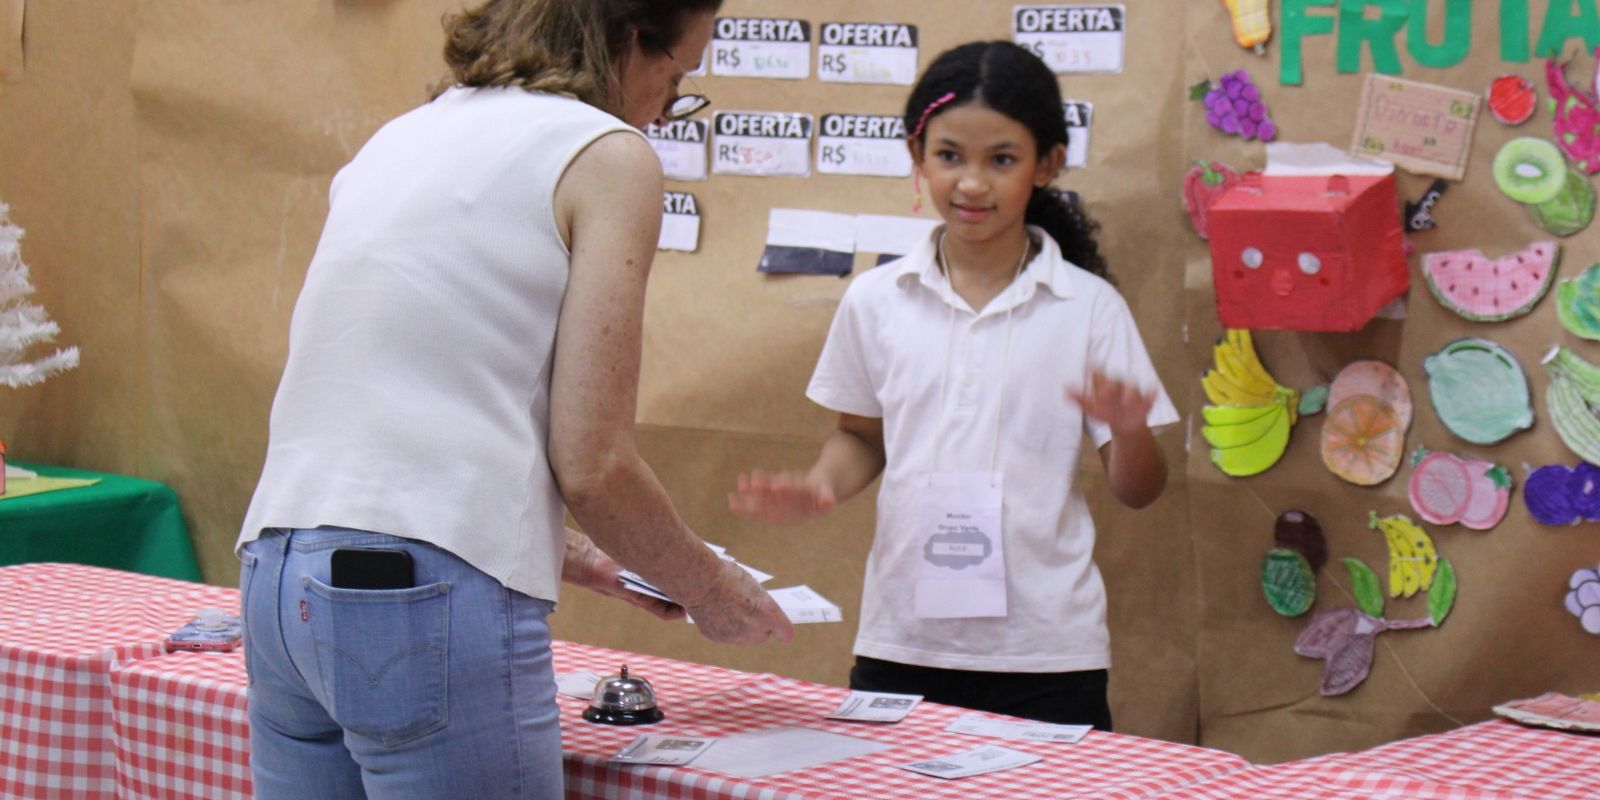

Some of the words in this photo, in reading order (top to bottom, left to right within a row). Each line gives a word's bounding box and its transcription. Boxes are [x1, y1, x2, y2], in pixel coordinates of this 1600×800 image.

[717, 17, 805, 42] OFERTA
[1020, 8, 1115, 32] OFERTA
[823, 23, 912, 48] OFERTA
[716, 48, 741, 67] R$
[822, 53, 848, 75] R$
[646, 119, 700, 142] ERTA
[720, 114, 804, 138] OFERTA
[824, 114, 907, 138] OFERTA
[718, 144, 739, 164] R$
[822, 145, 847, 165] R$
[663, 192, 697, 215] RTA
